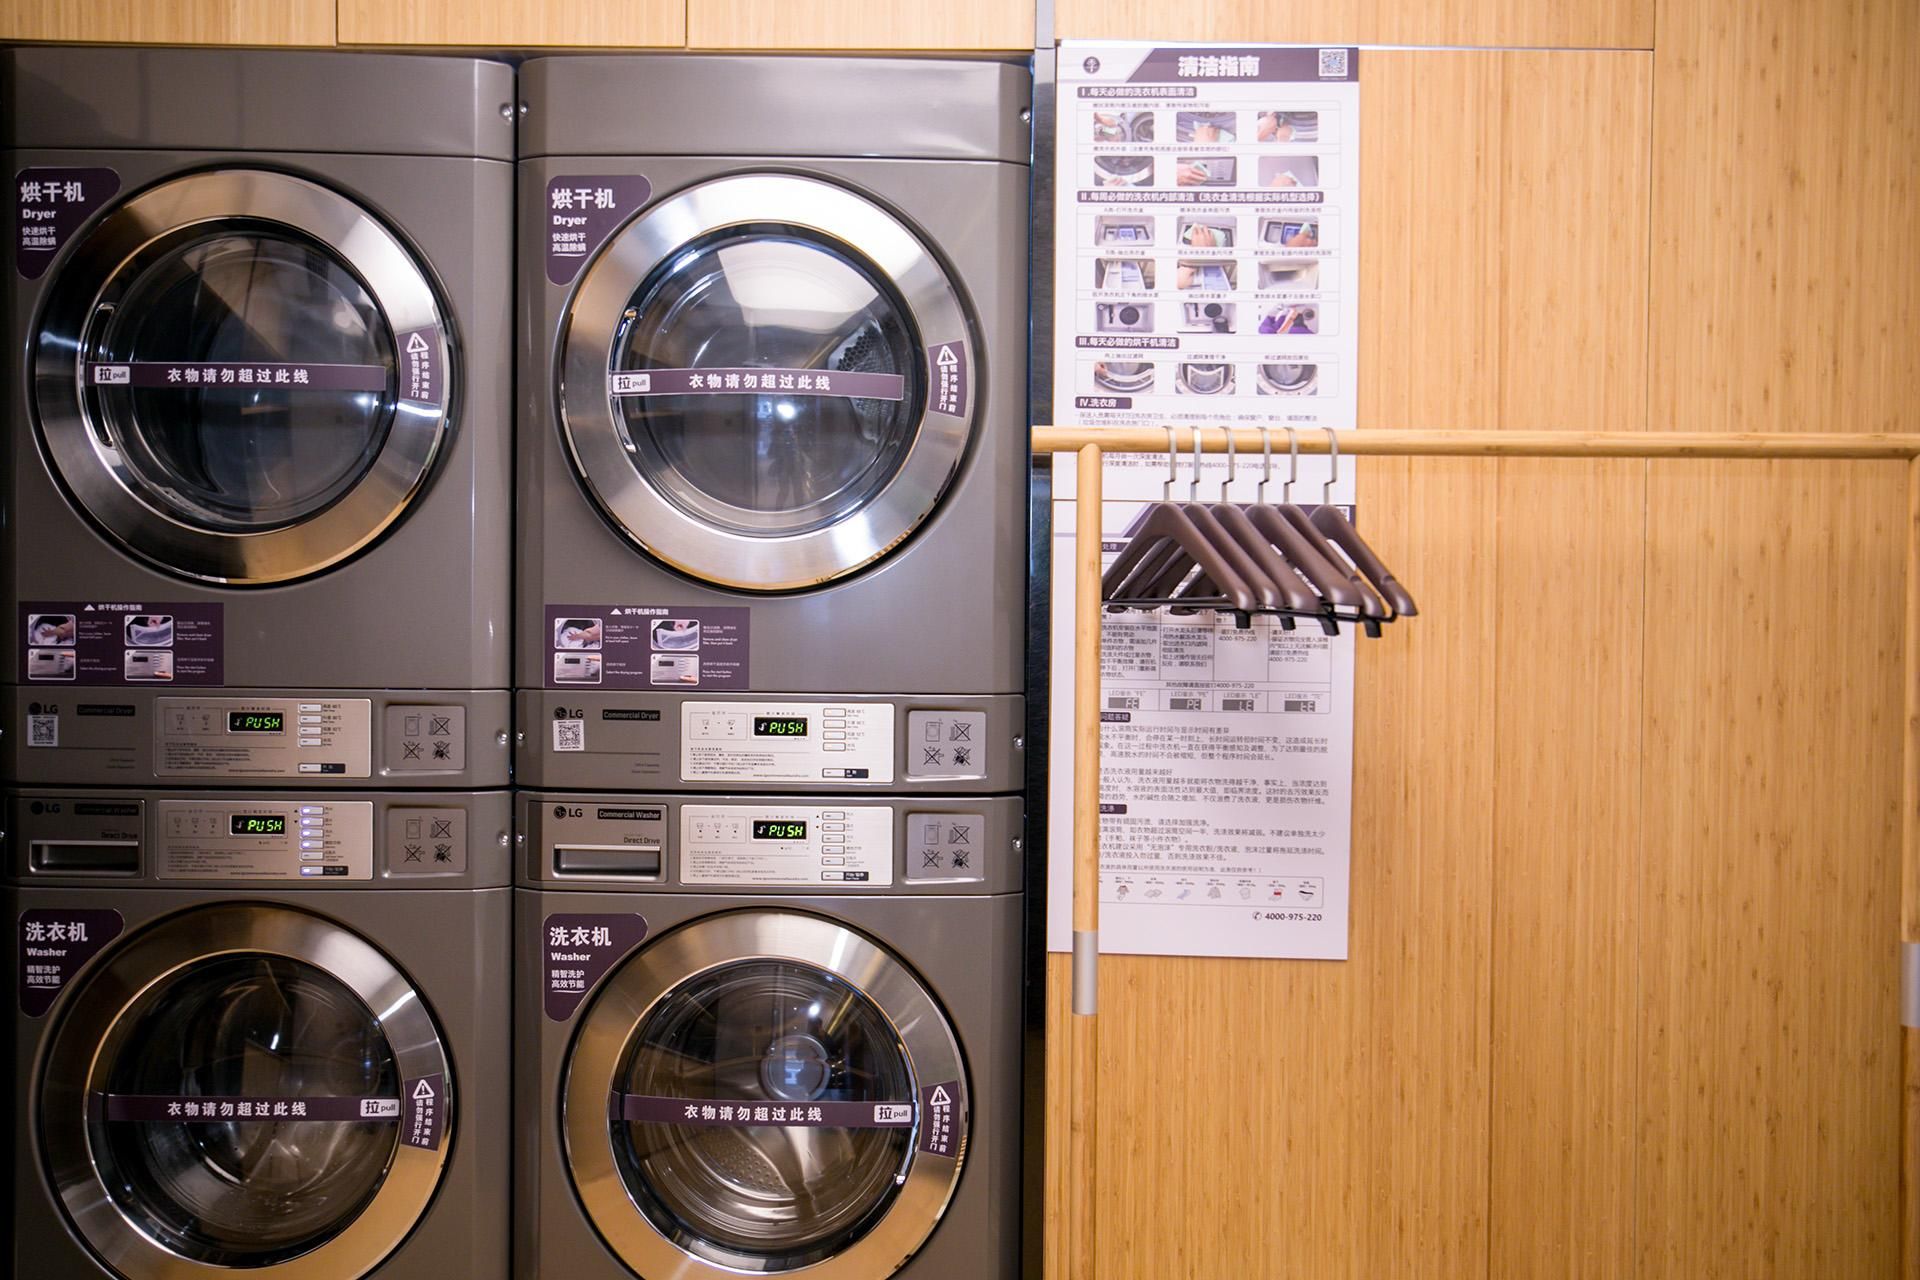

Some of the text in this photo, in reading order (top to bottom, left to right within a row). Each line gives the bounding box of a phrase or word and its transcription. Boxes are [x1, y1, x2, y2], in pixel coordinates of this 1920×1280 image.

[1178, 56, 1260, 77] 清洁指南
[20, 181, 85, 202] 烘干机
[552, 188, 616, 209] 烘干机
[22, 209, 56, 220] Dryer
[553, 215, 587, 227] Dryer
[22, 226, 56, 236] 快速烘干
[552, 233, 586, 242] 快速烘干
[22, 237, 56, 246] 高温除螨
[552, 243, 586, 252] 高温除螨
[99, 368, 127, 381] 拉 pull
[167, 368, 310, 385] 衣物请勿超过此线
[410, 352, 420, 398] 请勿强行开门
[420, 351, 430, 399] 程序结束前
[618, 376, 647, 390] 拉 pull
[689, 374, 831, 391] 衣物请勿超过此线
[938, 365, 949, 411] 请勿强行开门
[948, 364, 958, 413] 程序结束前
[1080, 398, 1117, 407] IV.洗衣房
[43, 704, 58, 714] LG
[569, 709, 584, 719] LG
[603, 711, 659, 720] Commercial Dryer
[245, 716, 281, 729] PUSH
[769, 721, 804, 734] PUSH
[45, 803, 61, 813] LG
[569, 808, 583, 818] LG
[599, 810, 660, 819] Commercial Washer
[247, 819, 283, 832] PUSH
[769, 825, 804, 837] PUSH
[1265, 912, 1322, 921] 4000-975-220
[25, 921, 88, 942] 洗衣机
[549, 926, 612, 947] 洗衣机
[26, 947, 67, 956] Washer
[551, 952, 591, 961] Washer
[26, 965, 61, 974] 精智洗护
[551, 969, 585, 978] 精智洗护
[26, 975, 61, 984] 高效节能
[551, 979, 585, 989] 高效节能
[167, 1101, 307, 1117] 衣物请勿超过此线
[365, 1101, 397, 1114] 拉 pull
[684, 1104, 823, 1122] 衣物请勿超过此线
[879, 1106, 908, 1120] 拉 pull
[411, 1099, 424, 1144] 请勿强行开门
[421, 1098, 433, 1146] 程序结束前
[929, 1105, 941, 1151] 请勿强行开门
[938, 1104, 950, 1153] 程序结束前
